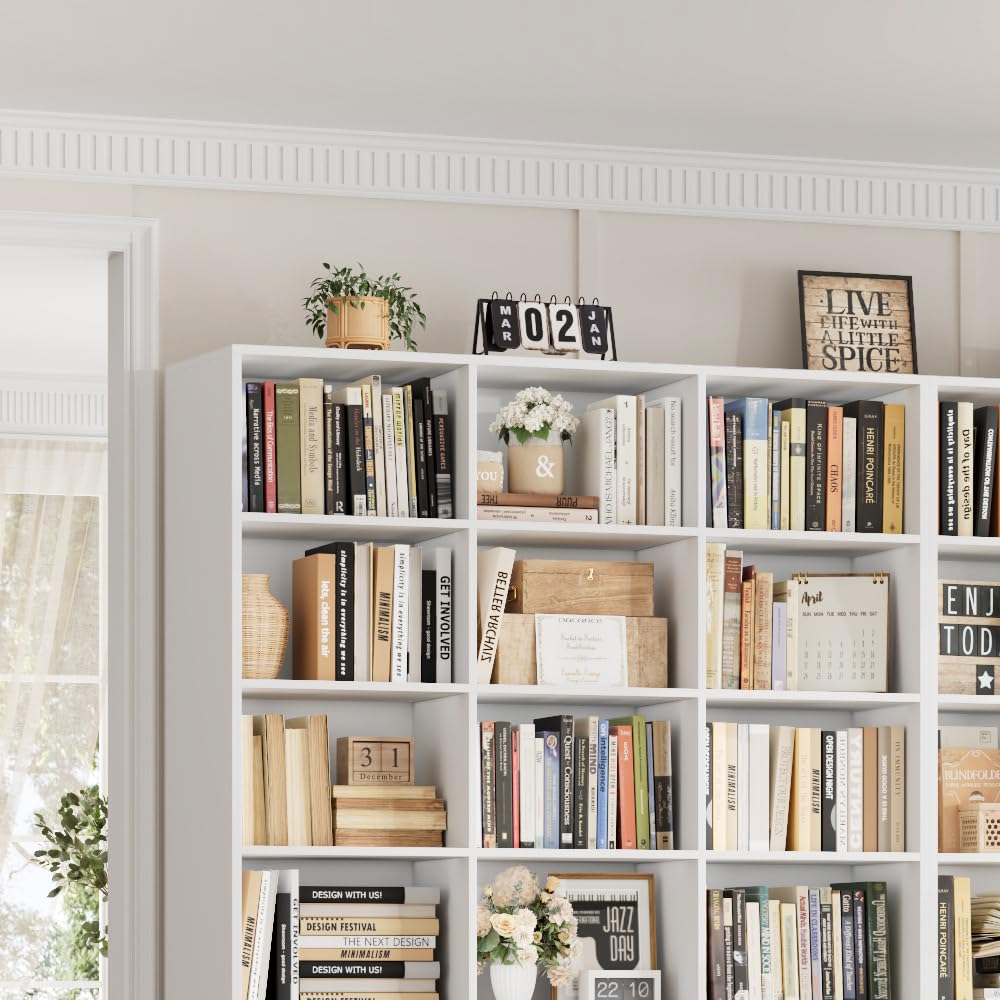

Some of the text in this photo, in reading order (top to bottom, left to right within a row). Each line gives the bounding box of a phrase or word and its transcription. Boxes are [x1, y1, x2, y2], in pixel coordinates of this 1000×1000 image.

[826, 289, 892, 316] LIVE
[500, 306, 601, 345] MAR 02 JAN
[821, 316, 897, 330] LIFE WITH
[821, 330, 898, 346] A LITTLE
[822, 346, 899, 372] SPICE
[865, 427, 875, 455] HENRI
[830, 464, 838, 492] CHAOS
[340, 598, 347, 606] in
[801, 591, 823, 606] April
[320, 602, 330, 657] clean the air
[378, 592, 390, 642] MINIMALISM
[440, 576, 450, 660] GET INVOLVED
[340, 650, 347, 660] we
[599, 737, 607, 792] intelligence
[728, 765, 736, 811] MINIMALISM
[306, 922, 376, 931] DESIGN FESTIVAL
[603, 906, 634, 933] JAZZ
[242, 916, 255, 967] MINIMALISM
[340, 950, 390, 959] MINIMALISM
[343, 938, 429, 946] THE NEXT DESIGN
[610, 936, 634, 962] DAY
[597, 982, 649, 998] 22 10
